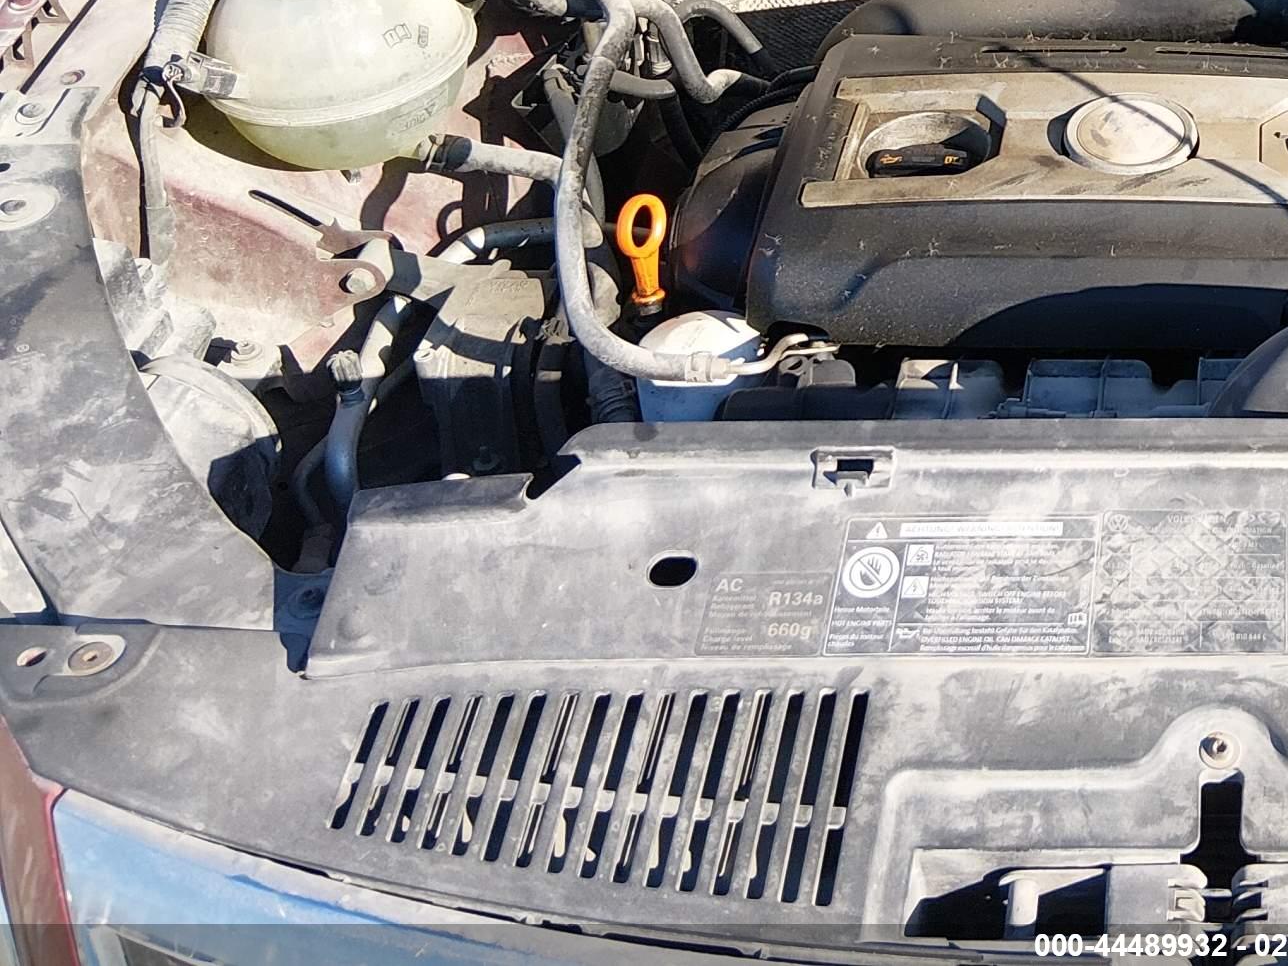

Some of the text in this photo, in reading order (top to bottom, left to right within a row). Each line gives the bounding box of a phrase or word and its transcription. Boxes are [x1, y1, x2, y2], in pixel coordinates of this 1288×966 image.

[715, 578, 743, 592] AC
[768, 591, 823, 606] R134a
[767, 622, 812, 640] 660g
